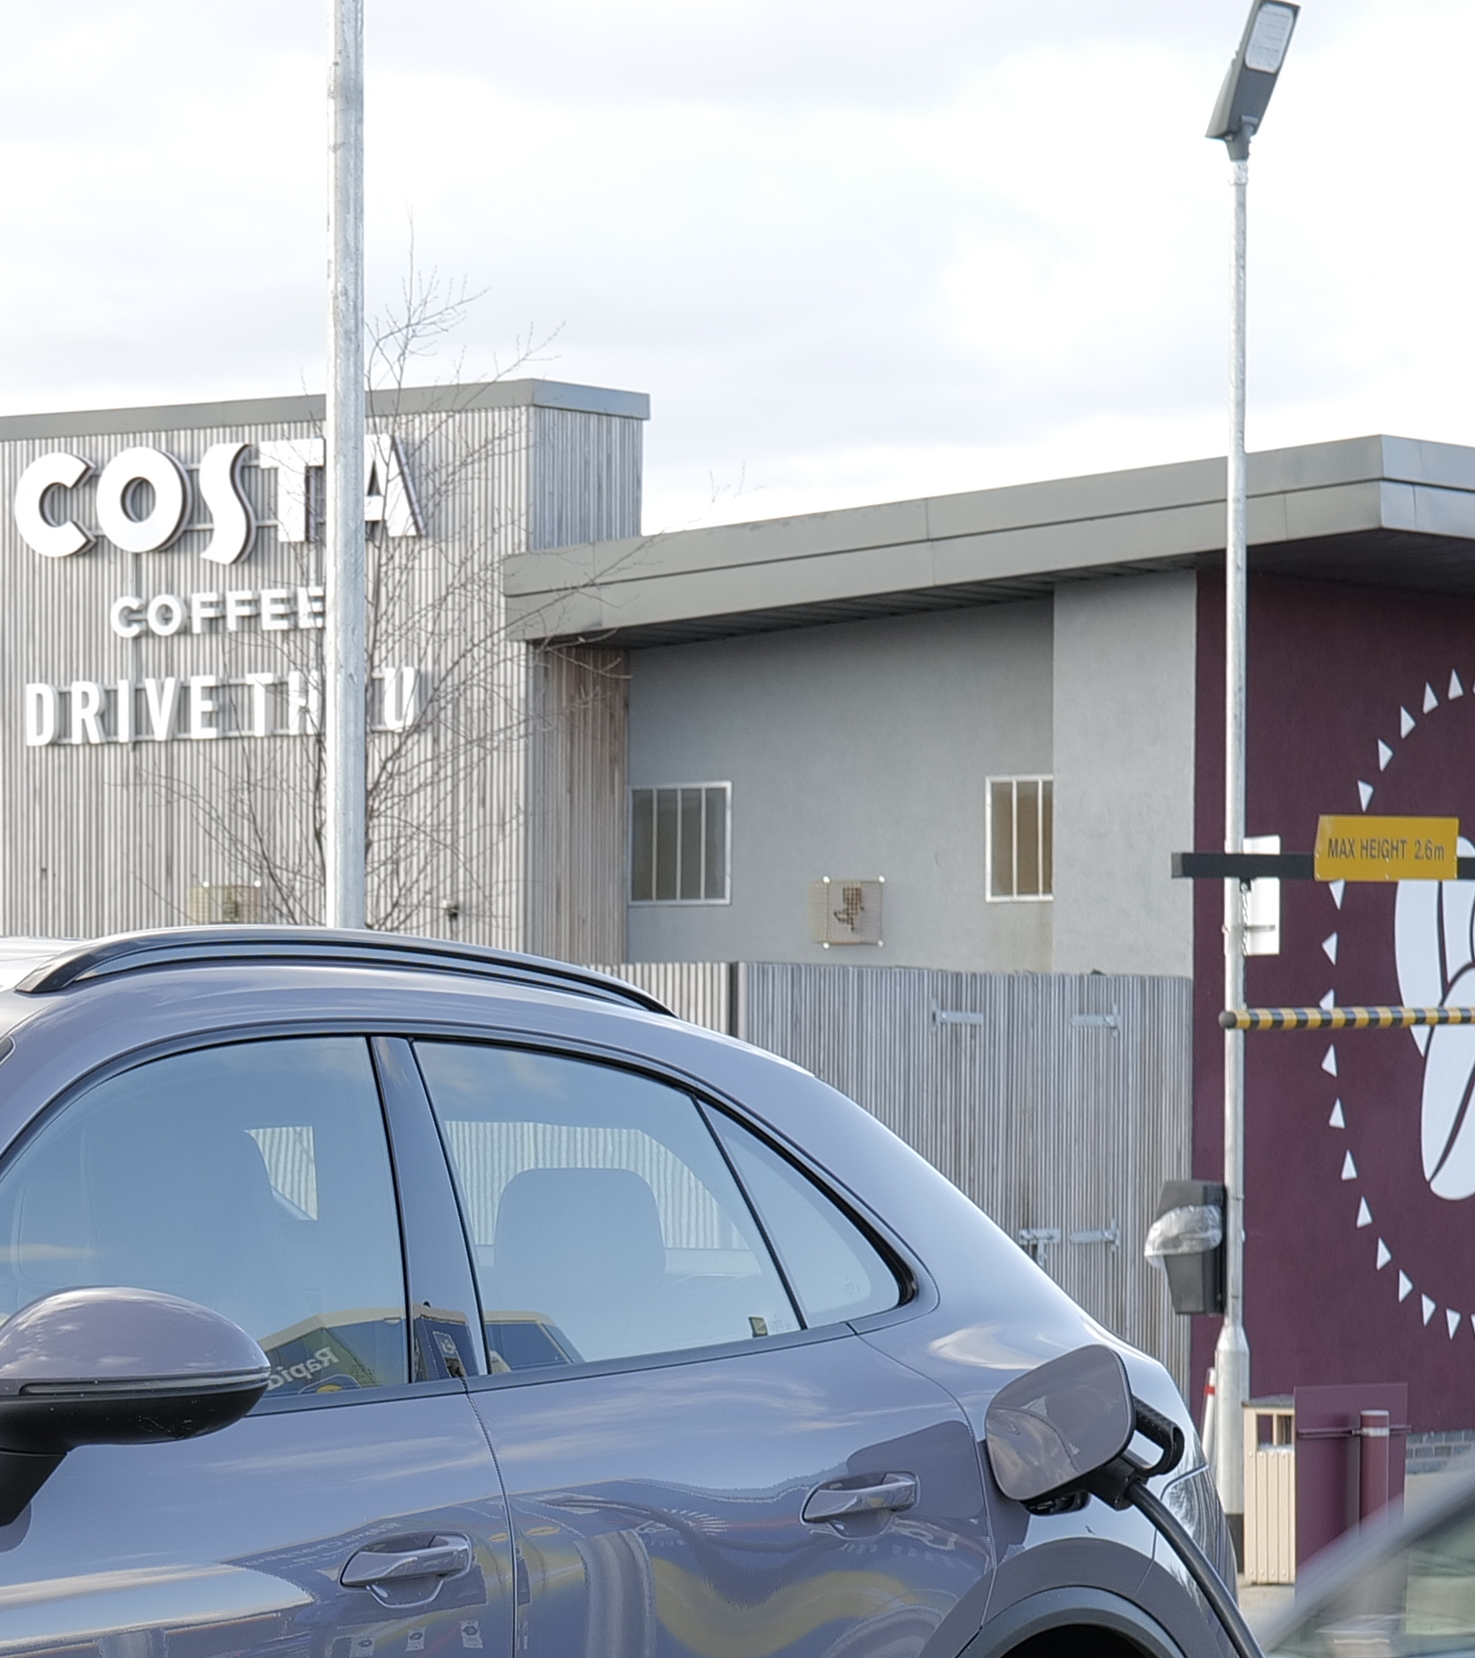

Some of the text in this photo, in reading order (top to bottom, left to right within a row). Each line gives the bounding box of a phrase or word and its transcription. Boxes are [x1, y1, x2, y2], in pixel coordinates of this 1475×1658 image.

[14, 433, 426, 565] COSTA
[110, 586, 327, 639] COFFEE
[25, 666, 420, 748] DRIVE THU
[1328, 838, 1446, 862] MAX HEIGHT 2.6m
